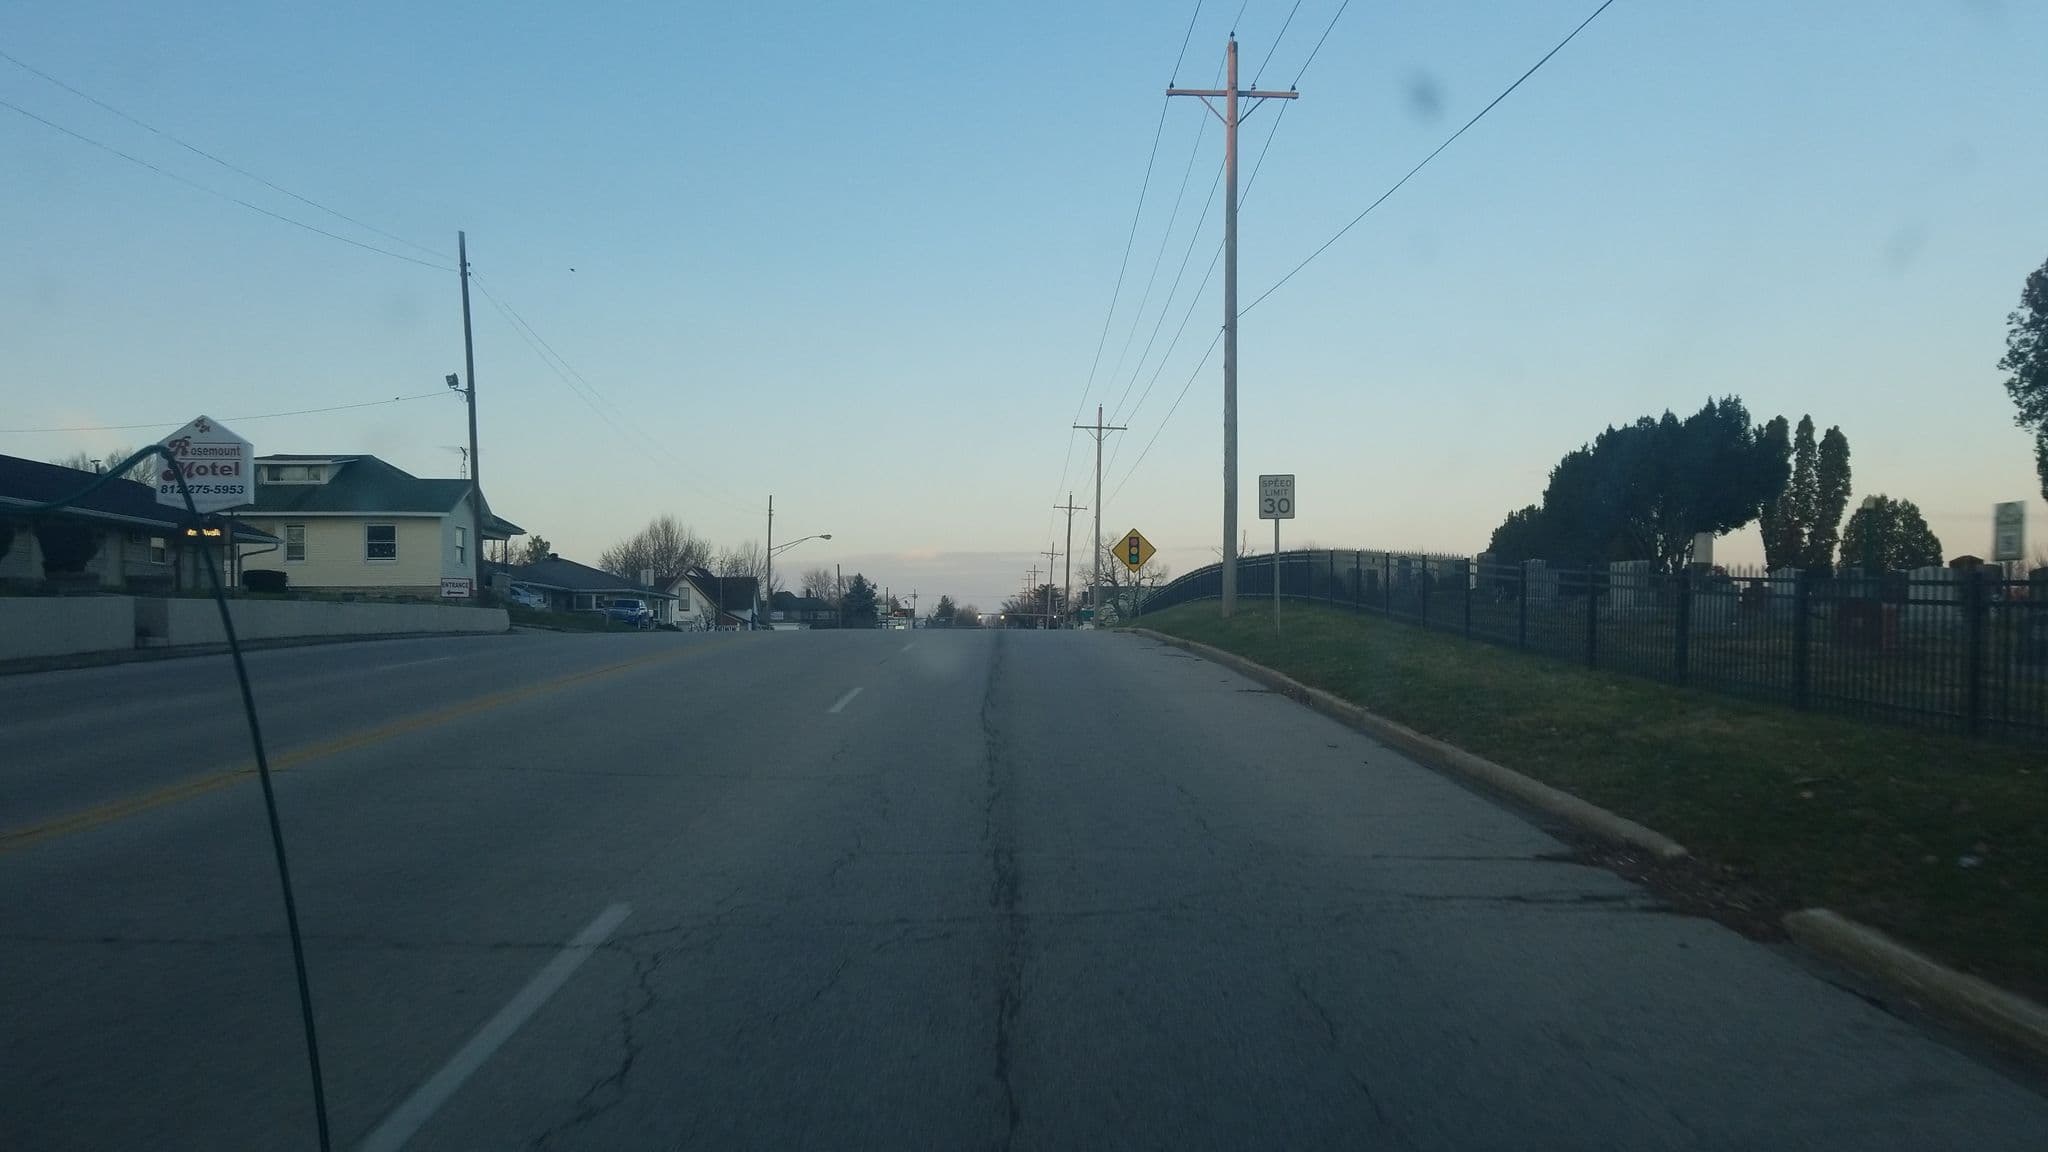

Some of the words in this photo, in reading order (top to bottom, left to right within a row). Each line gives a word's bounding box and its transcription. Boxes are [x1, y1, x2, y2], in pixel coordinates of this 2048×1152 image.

[168, 436, 241, 456] Rosemount
[162, 461, 240, 481] Motel
[161, 484, 244, 494] 812275-5953
[1263, 480, 1292, 488] SPEED
[1264, 489, 1288, 497] LIMIT
[1263, 498, 1290, 513] 30
